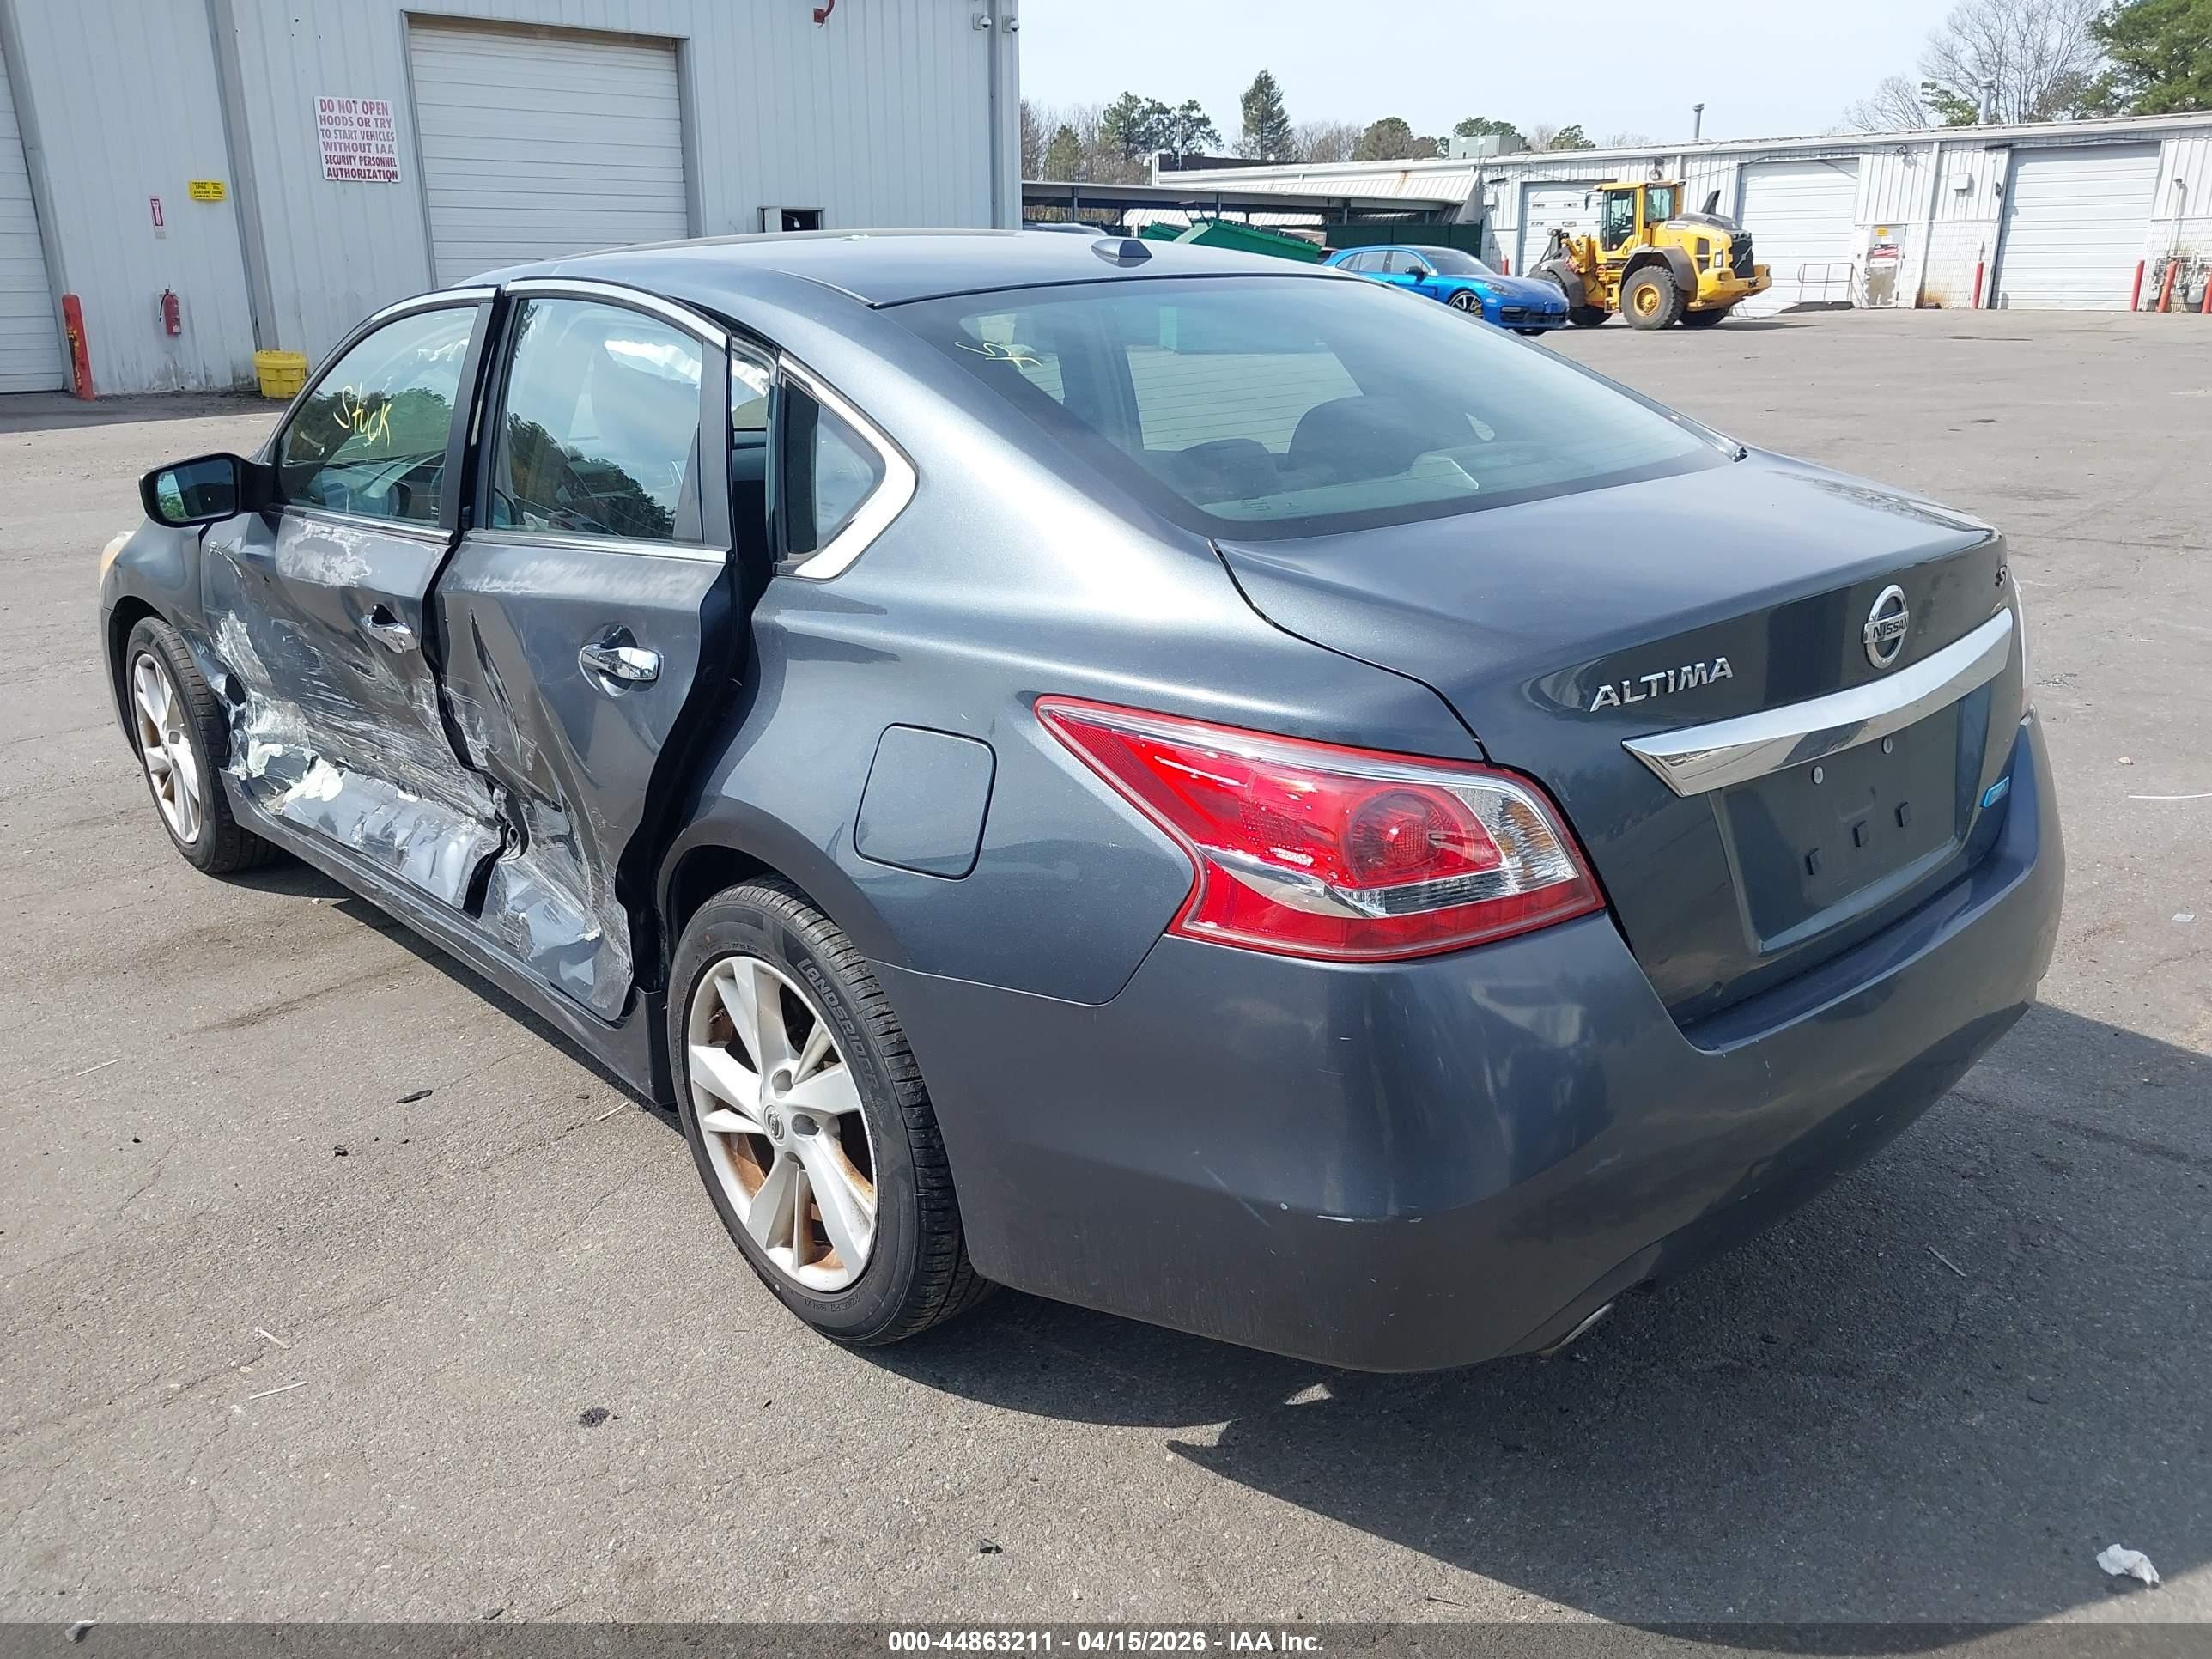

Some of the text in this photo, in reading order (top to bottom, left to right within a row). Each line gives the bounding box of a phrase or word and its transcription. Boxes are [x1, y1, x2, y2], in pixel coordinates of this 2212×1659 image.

[319, 99, 389, 116] DO NOT OPEN
[319, 114, 392, 129] HOODS OR TRY
[319, 128, 395, 142] TO START VEHICLES
[322, 141, 395, 155] WITHOUT IAA
[325, 155, 398, 167] SECURITY PERSONNEL
[326, 167, 398, 180] AUTHORIZATION
[1873, 617, 1908, 639] NISSAN
[1589, 656, 1734, 713] ALTIMA
